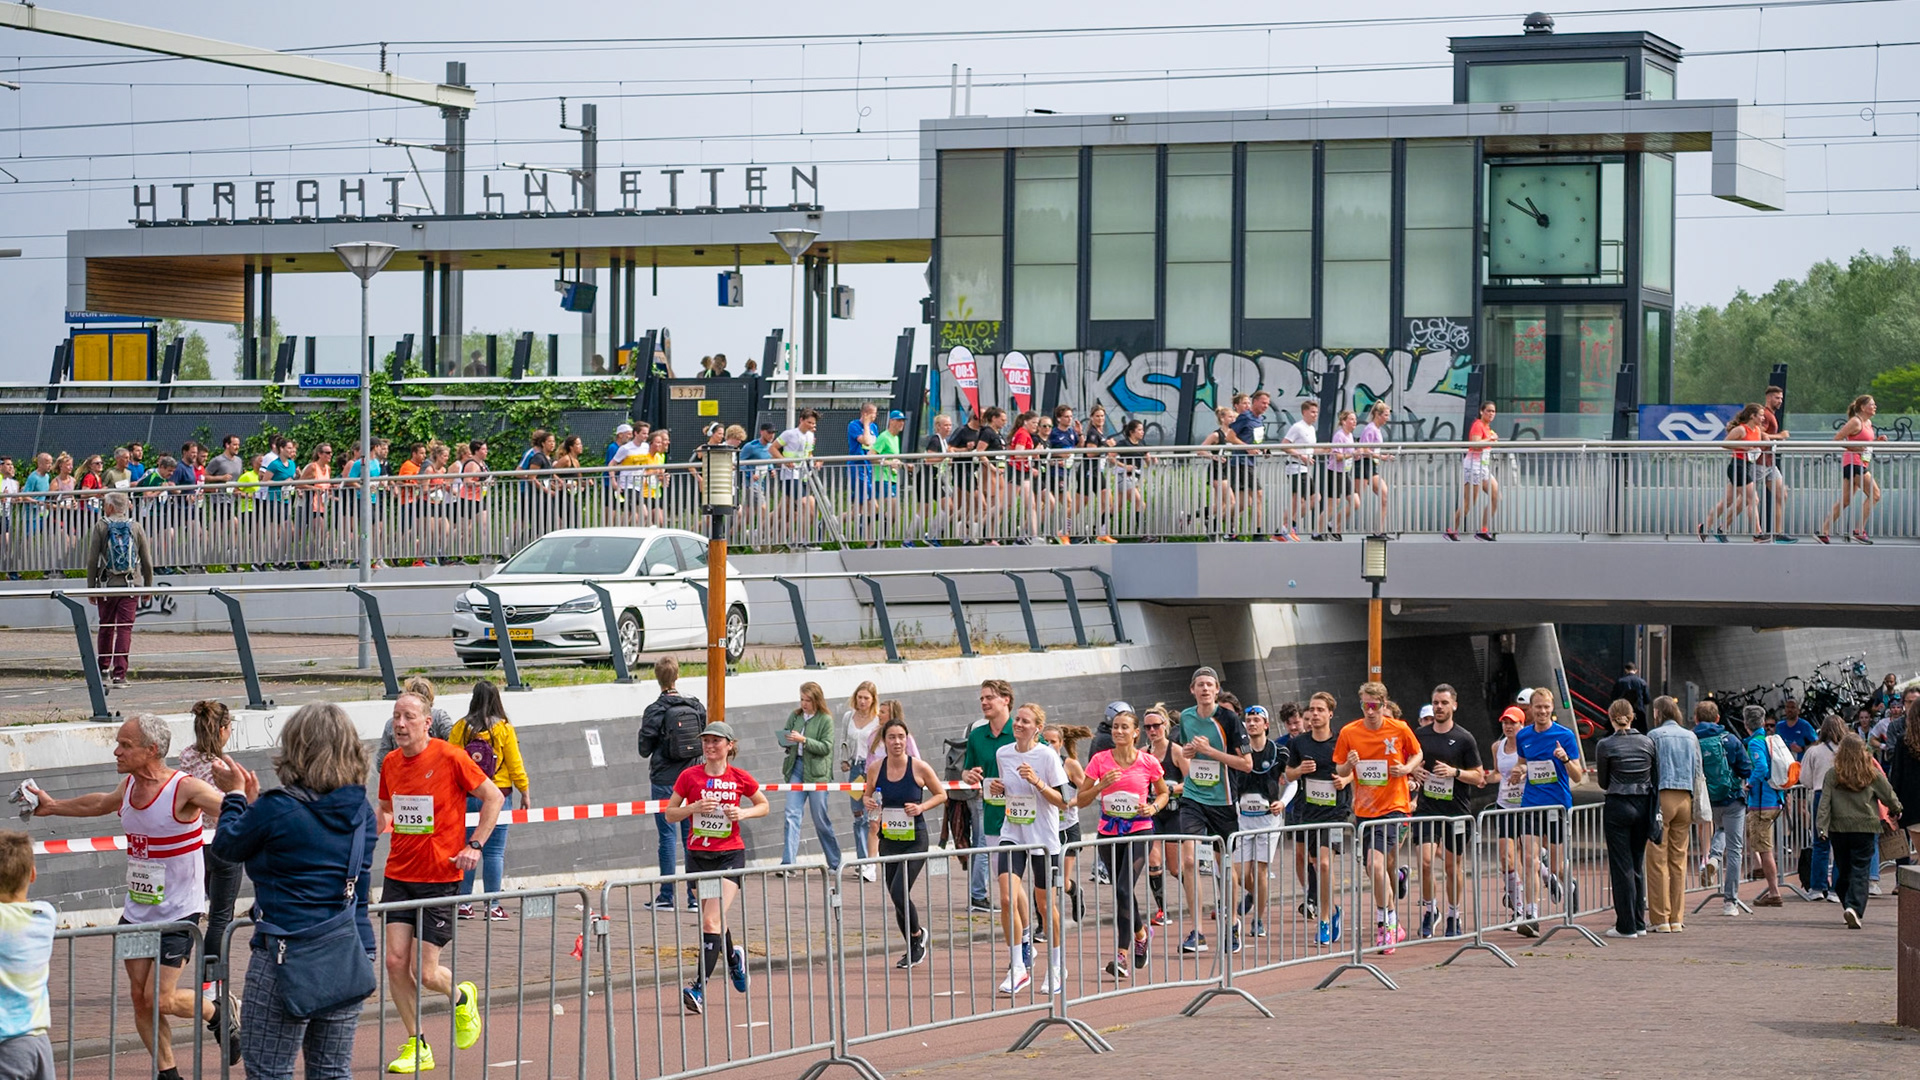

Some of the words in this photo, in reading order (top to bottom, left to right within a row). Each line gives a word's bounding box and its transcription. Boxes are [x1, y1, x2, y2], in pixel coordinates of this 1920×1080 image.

[133, 177, 406, 207] UTRECHT
[732, 285, 739, 303] 2
[312, 377, 323, 385] De
[324, 377, 355, 385] Wadden
[678, 388, 704, 398] 3.377
[1194, 771, 1213, 780] 8372
[1362, 771, 1381, 779] 9933
[706, 778, 738, 790] #Ren
[700, 789, 737, 802] tegen
[1311, 790, 1330, 798] 9955
[1110, 804, 1132, 812] 9016
[397, 814, 423, 824] 9158
[887, 820, 907, 828] 9943
[700, 820, 724, 830] 9267
